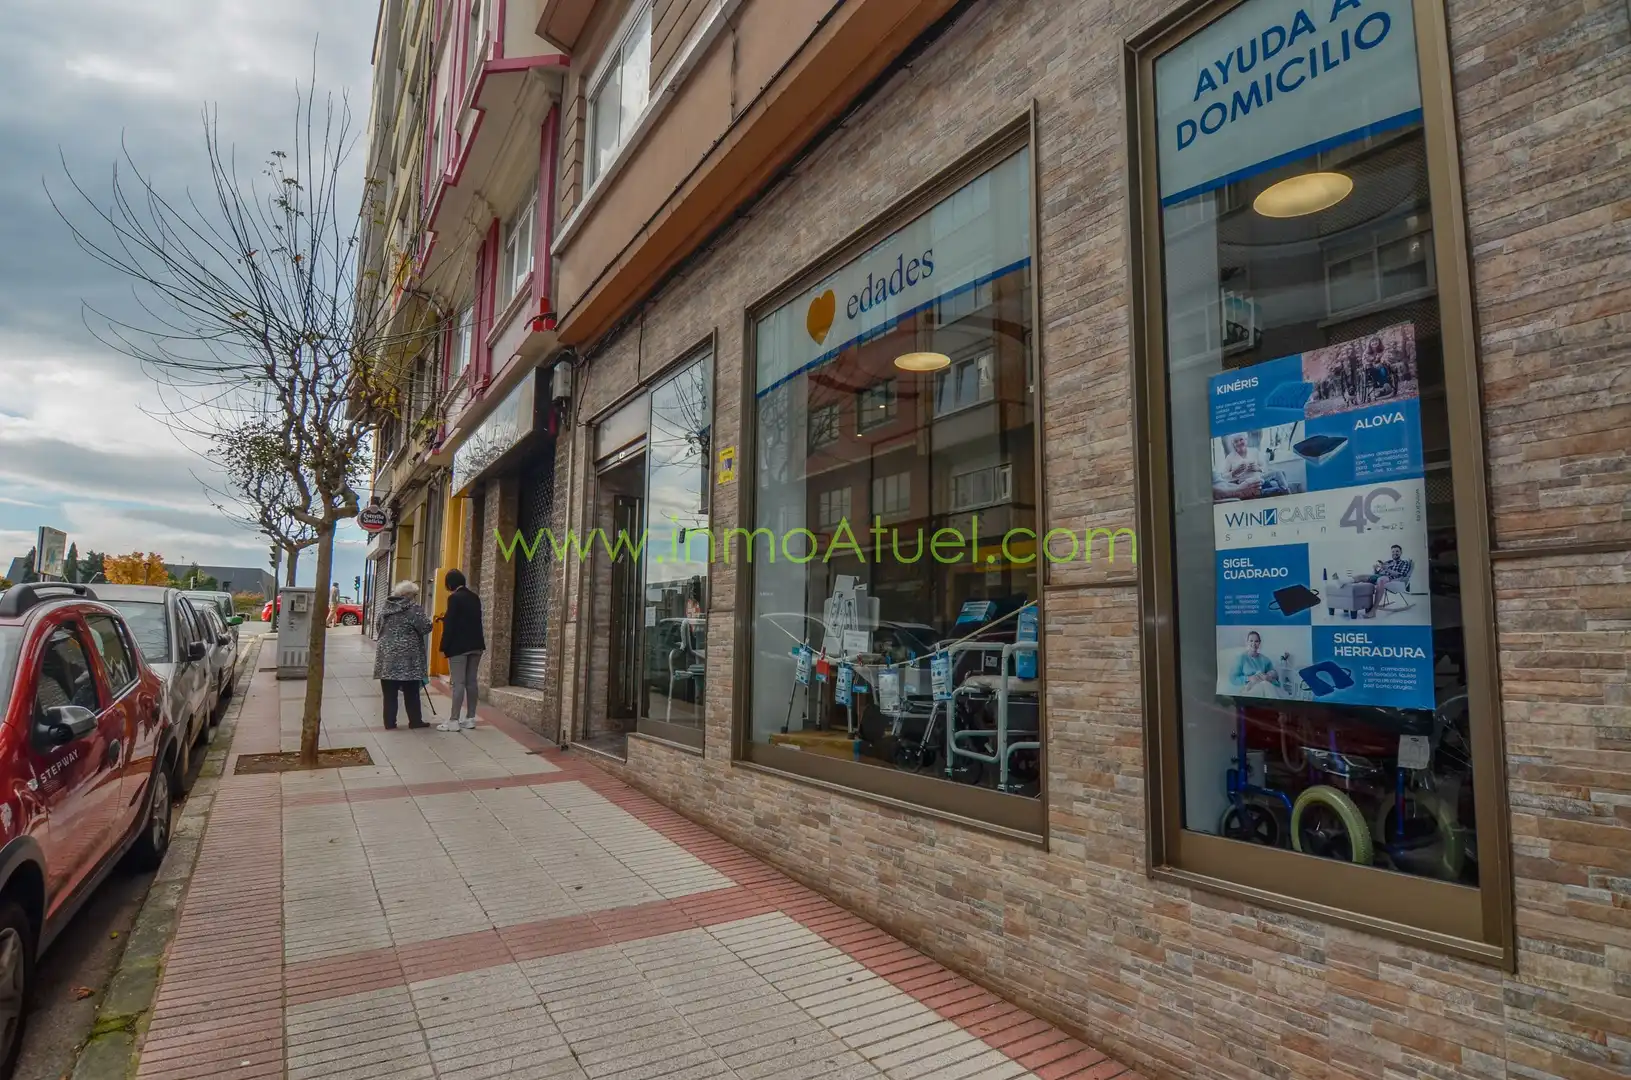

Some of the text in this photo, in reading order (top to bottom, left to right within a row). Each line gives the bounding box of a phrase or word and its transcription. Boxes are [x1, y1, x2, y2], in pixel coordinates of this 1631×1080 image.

[1194, 8, 1316, 102] AYUDA
[1176, 11, 1391, 151] DOMICILIO
[846, 248, 934, 320] edades
[1216, 376, 1259, 396] KINÉRIS
[1354, 412, 1404, 430] ALOVA
[1223, 558, 1254, 568] SIGEL
[1224, 567, 1288, 580] CUADRADO
[1334, 632, 1372, 644] SIGEL
[1334, 646, 1426, 658] HERRADURA
[40, 748, 78, 784] STEPWAY
